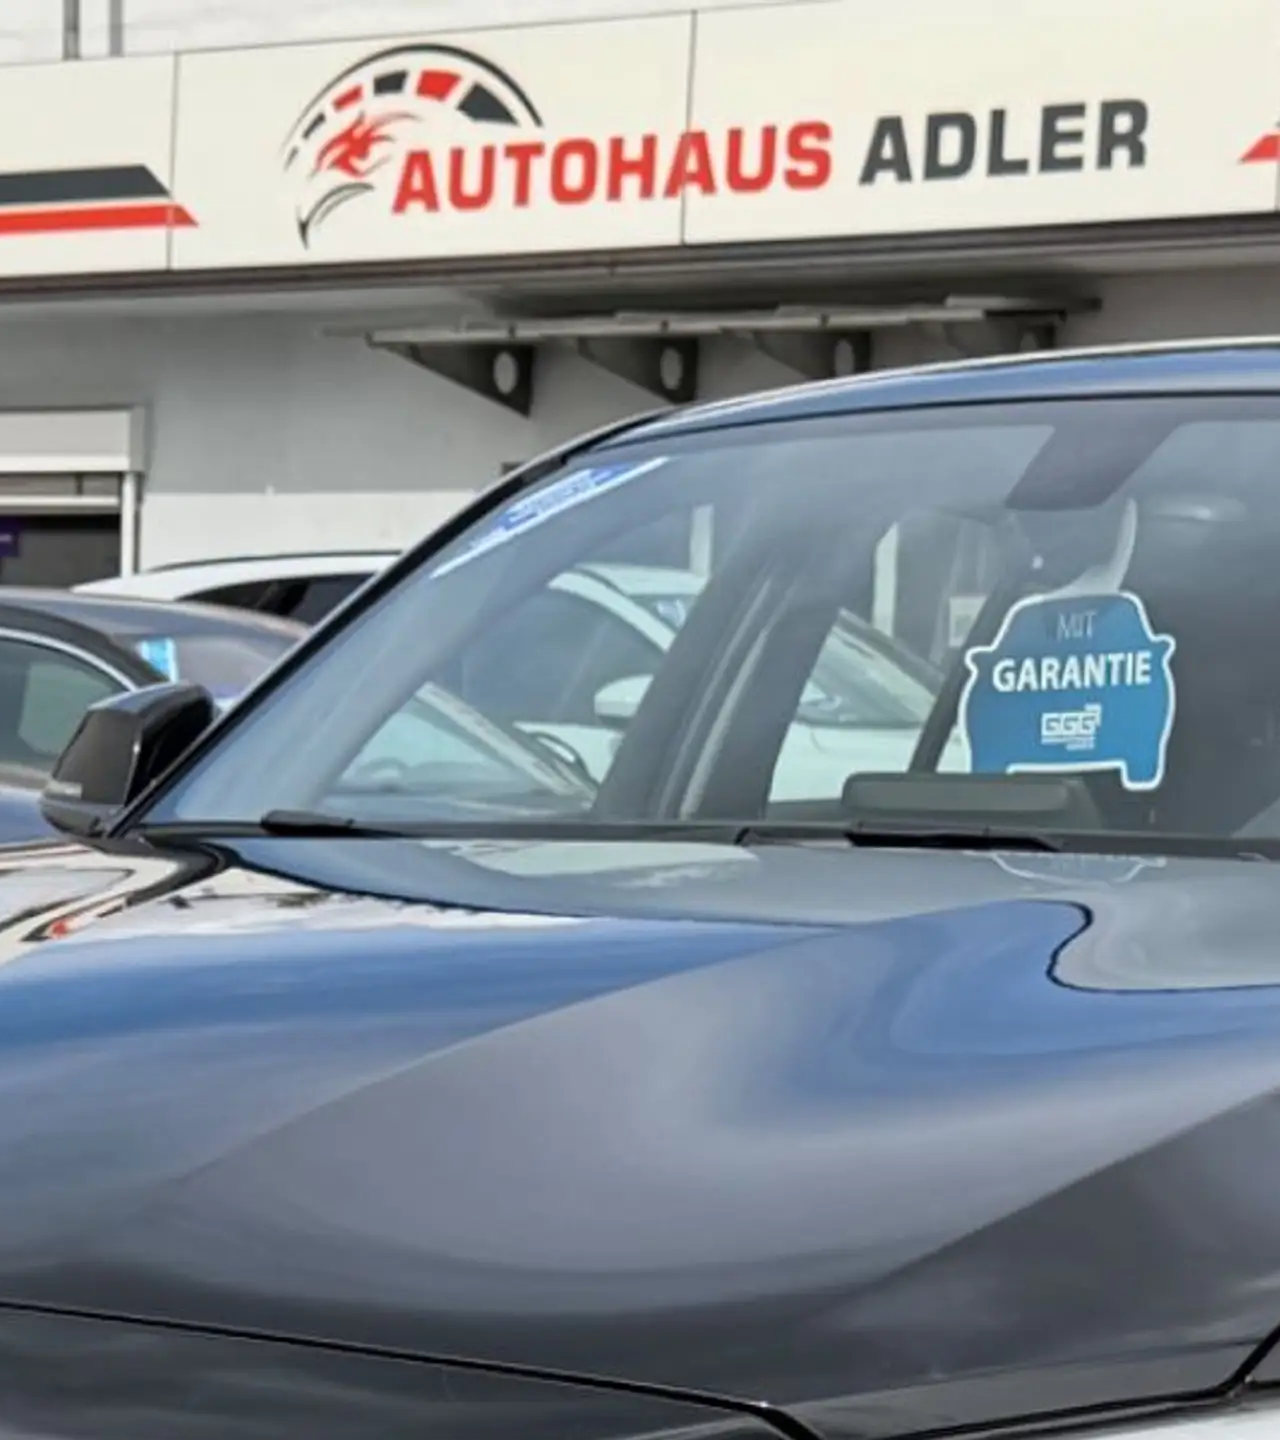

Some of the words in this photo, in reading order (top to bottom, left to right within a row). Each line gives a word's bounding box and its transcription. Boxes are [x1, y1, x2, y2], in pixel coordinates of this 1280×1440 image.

[390, 121, 832, 214] AUTOHAUS
[858, 98, 1149, 186] ADLER
[992, 651, 1153, 692] GARANTIE
